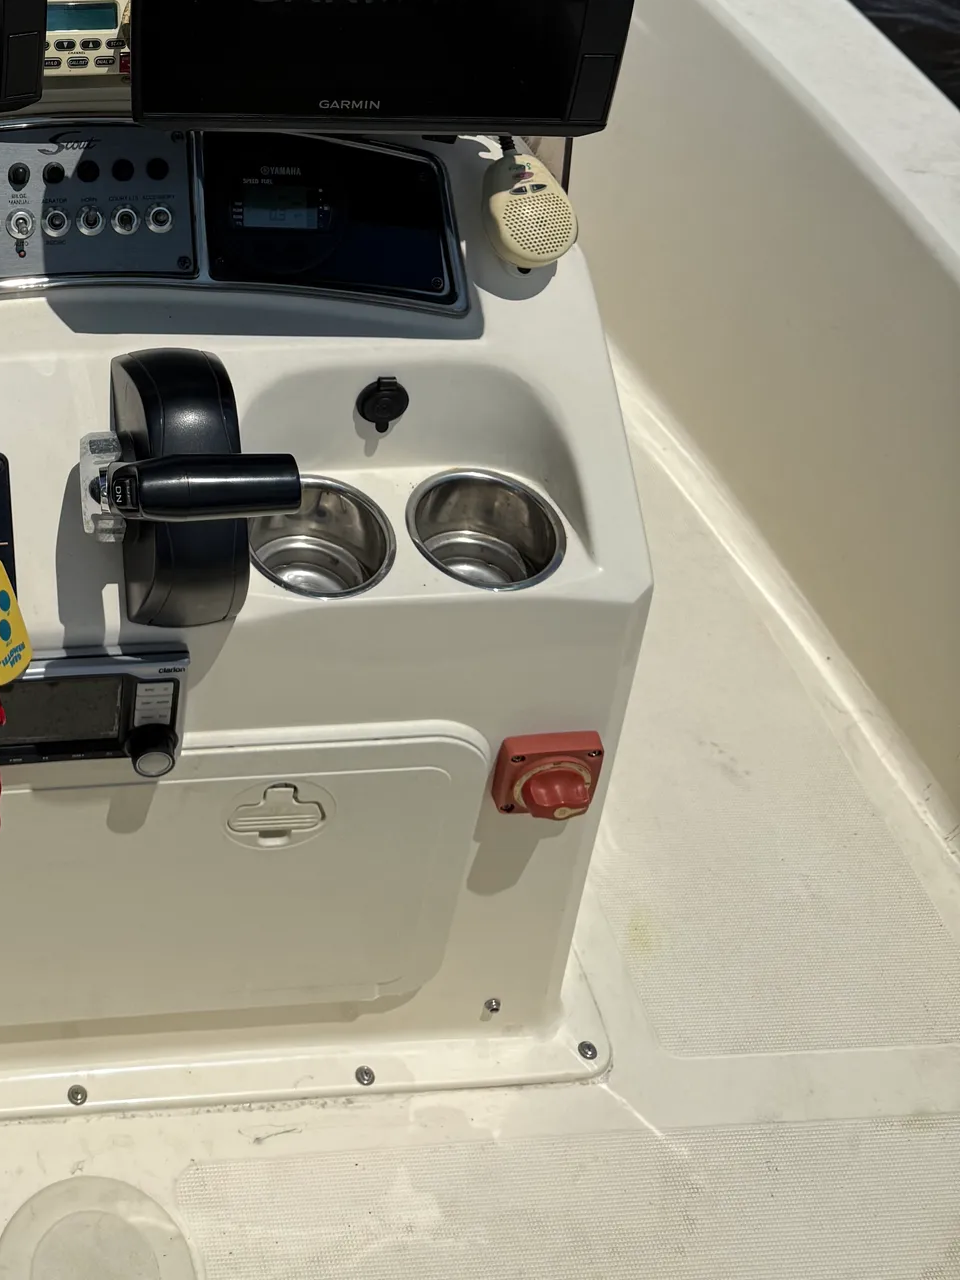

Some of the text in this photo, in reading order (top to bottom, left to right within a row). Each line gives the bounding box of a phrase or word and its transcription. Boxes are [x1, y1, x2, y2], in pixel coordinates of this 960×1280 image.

[318, 99, 381, 111] GARMIN
[37, 130, 103, 156] Scout
[269, 166, 302, 176] YAMAHA
[115, 486, 123, 503] DN
[158, 666, 186, 674] clarion
